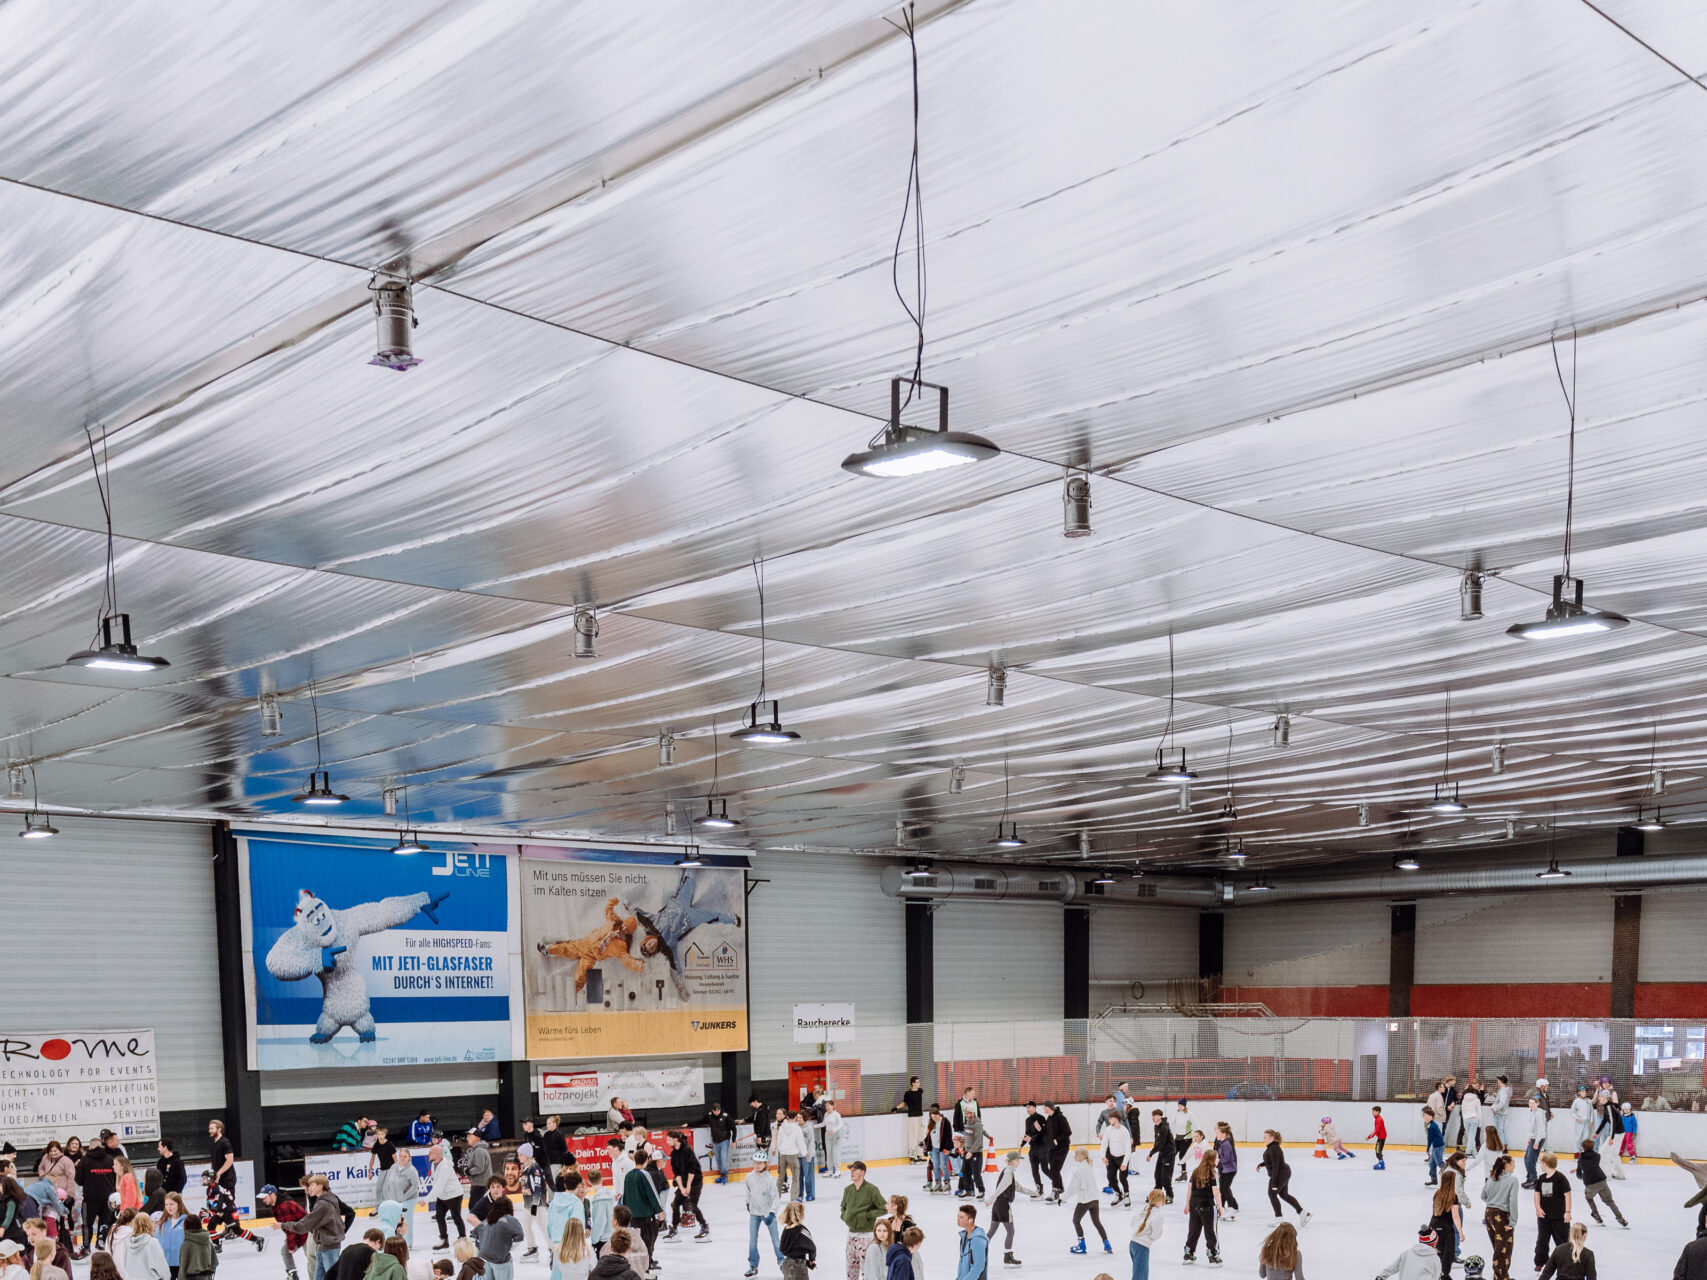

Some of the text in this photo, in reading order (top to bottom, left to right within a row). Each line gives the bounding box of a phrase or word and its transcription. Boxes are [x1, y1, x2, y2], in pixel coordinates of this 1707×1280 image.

[533, 870, 647, 884] Mit uns müssen Sie nicht
[534, 885, 606, 897] im Kalten sitzen
[405, 938, 493, 948] Für alle HIGHSPEED-Fans:
[372, 956, 493, 971] MIT JETI-GLASFASER
[717, 956, 734, 964] WHS
[445, 976, 494, 989] INTERNET!
[700, 1021, 736, 1030] JUNKERS
[797, 1017, 851, 1028] Raucherecke
[539, 1025, 602, 1035] Wärme fürs Leben
[81, 1068, 100, 1077] FOR
[111, 1065, 152, 1075] EVENTS
[91, 1083, 155, 1094] VERMIETUNG
[543, 1089, 599, 1101] holzprojekt
[80, 1095, 156, 1108] INSTALLATION
[113, 1108, 156, 1119] SERVICE
[576, 1148, 594, 1158] Dein
